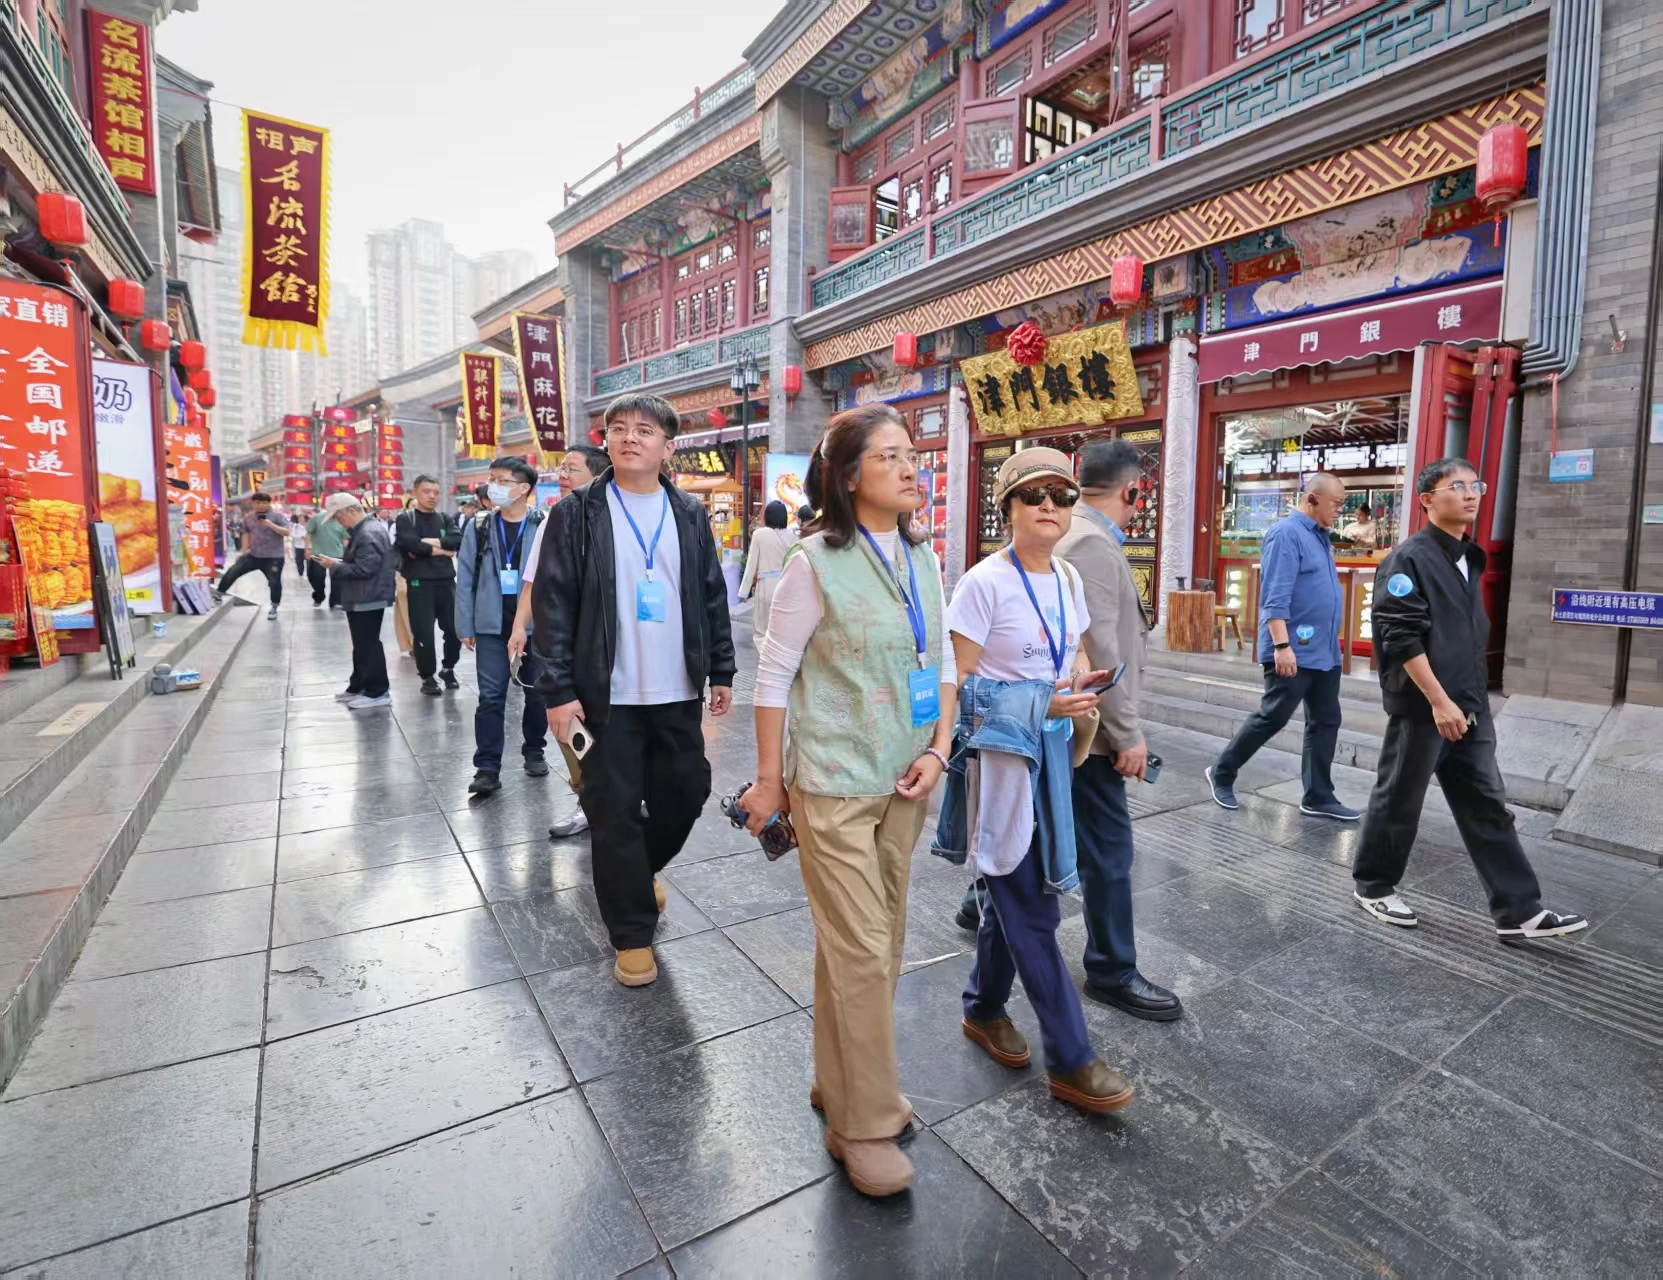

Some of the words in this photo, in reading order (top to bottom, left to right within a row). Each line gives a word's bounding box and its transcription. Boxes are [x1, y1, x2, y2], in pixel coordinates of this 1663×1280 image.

[101, 18, 146, 181] 名流茶馆相声
[255, 127, 319, 156] 相声
[1244, 305, 1462, 362] 津門銀樓
[526, 322, 559, 427] 津門麻花
[977, 350, 1116, 418] 津門銀樓
[16, 346, 73, 477] 全国邮递
[1570, 594, 1656, 611] 沿线附近埋有高压电缆
